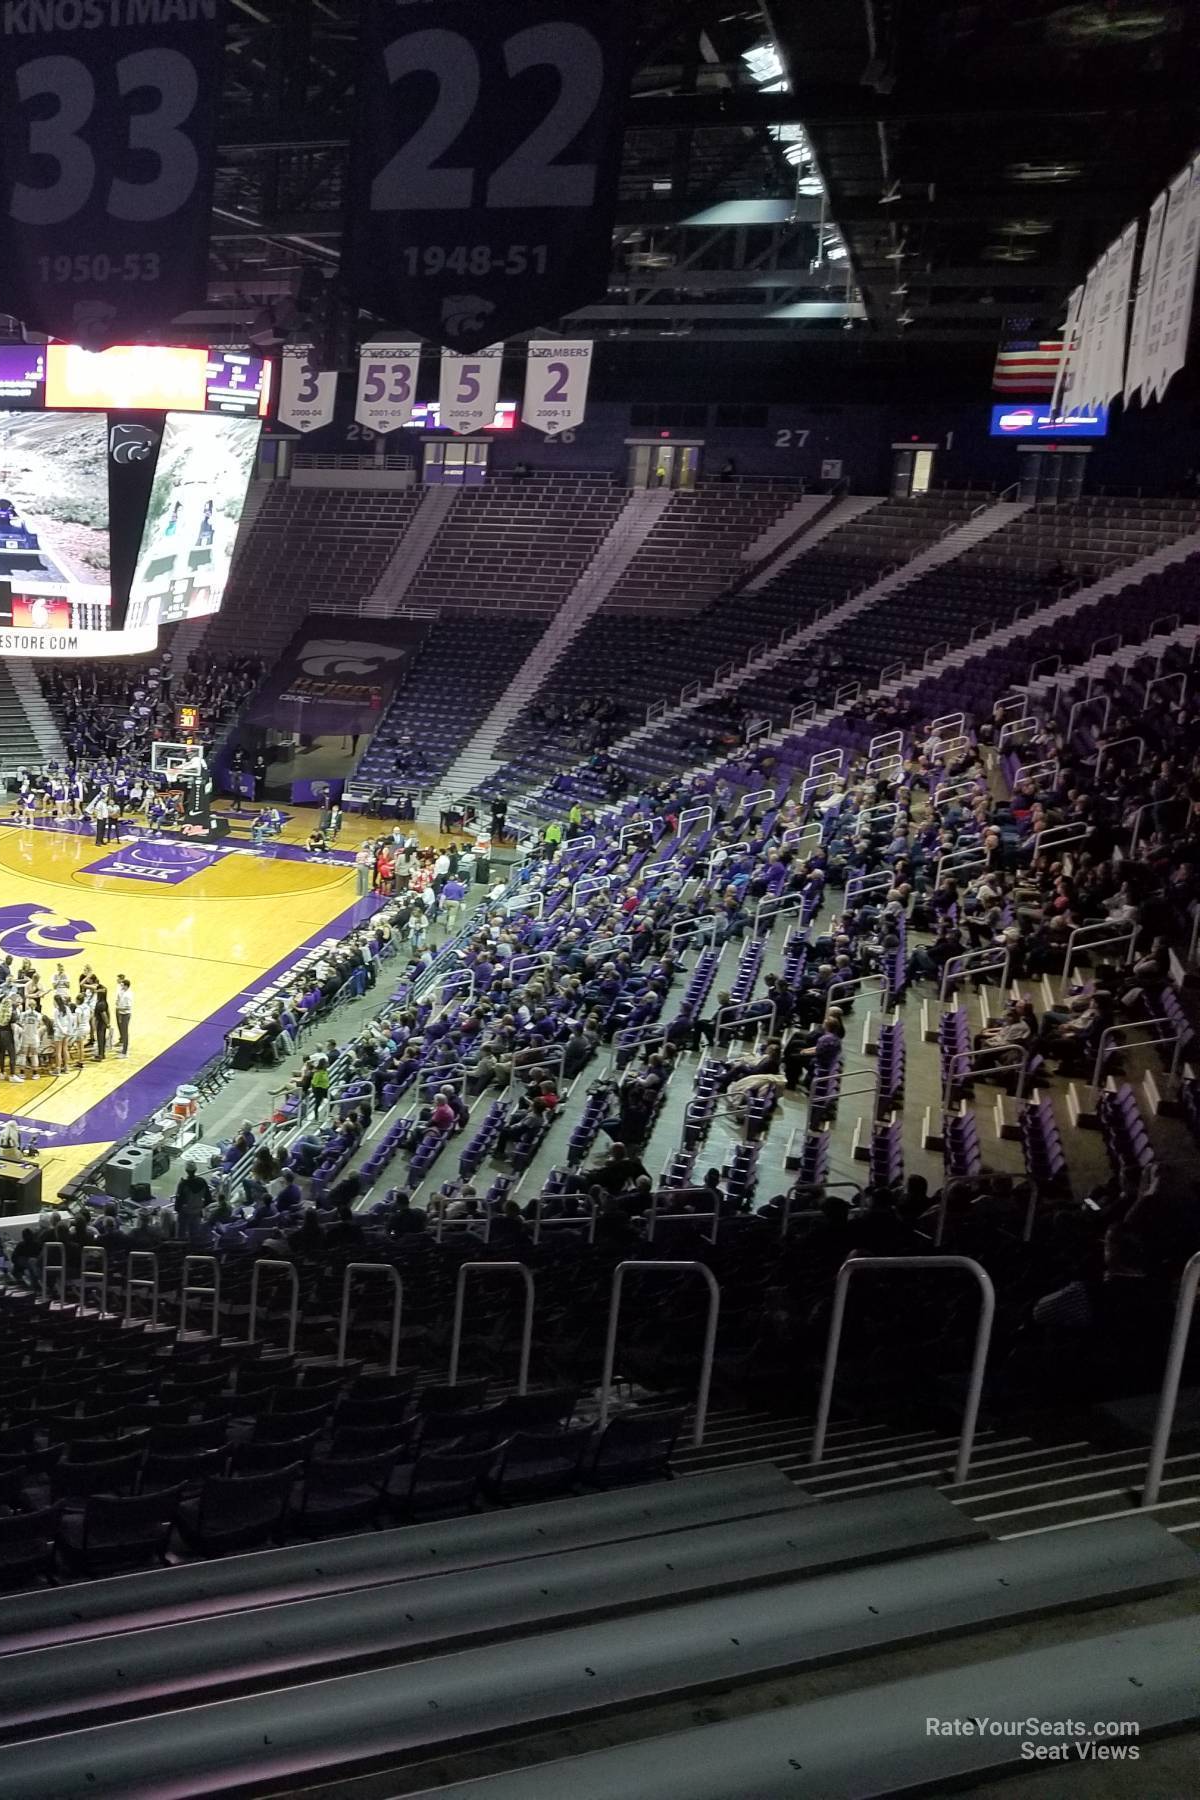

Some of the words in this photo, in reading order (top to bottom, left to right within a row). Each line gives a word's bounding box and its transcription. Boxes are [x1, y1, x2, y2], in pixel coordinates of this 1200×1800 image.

[4, 0, 216, 34] KNOSTMAN
[370, 21, 603, 211] 22
[9, 48, 199, 225] 33
[40, 252, 160, 282] 1950-53
[404, 244, 547, 277] 1948-51
[297, 365, 319, 402] 3
[363, 364, 411, 403] 53
[457, 364, 481, 403] 5
[544, 362, 570, 403] 2
[536, 409, 571, 417] 2009-13
[346, 424, 375, 441] 25
[776, 427, 809, 448] 27
[32, 598, 49, 628] 6
